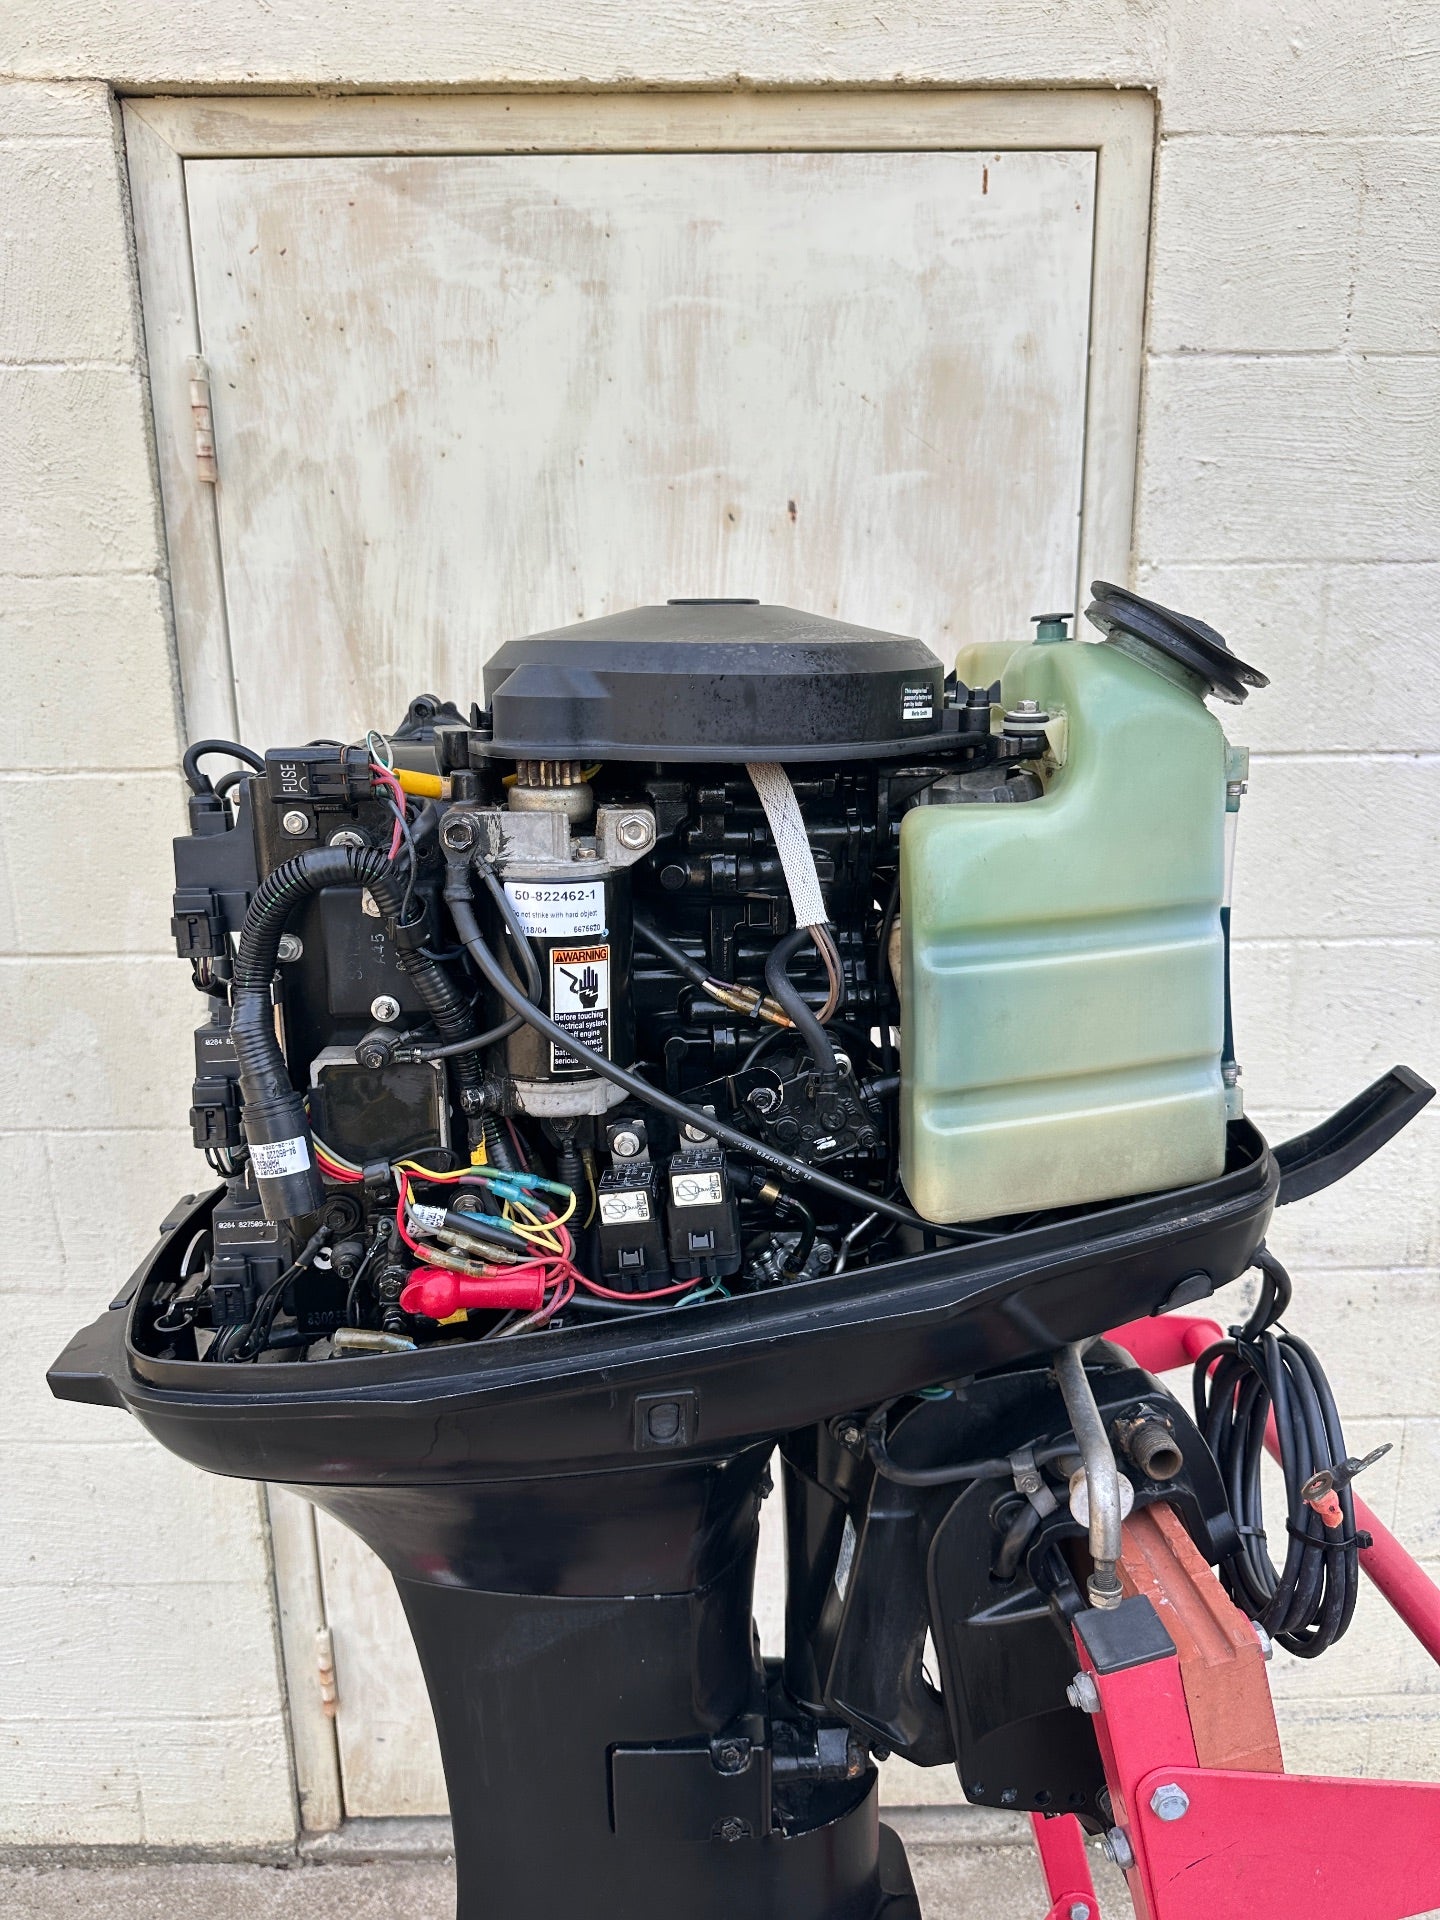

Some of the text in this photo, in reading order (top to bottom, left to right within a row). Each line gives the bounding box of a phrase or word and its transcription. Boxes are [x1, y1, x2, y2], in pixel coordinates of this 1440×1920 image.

[280, 763, 298, 792] FUSE
[515, 889, 595, 901] 50-822462-1
[563, 949, 607, 962] WARNING
[554, 1011, 603, 1021] Before touching
[558, 1021, 584, 1030] lectrical
[580, 1030, 600, 1038] engine
[757, 1150, 783, 1166] COPPER
[787, 1165, 801, 1175] SAE
